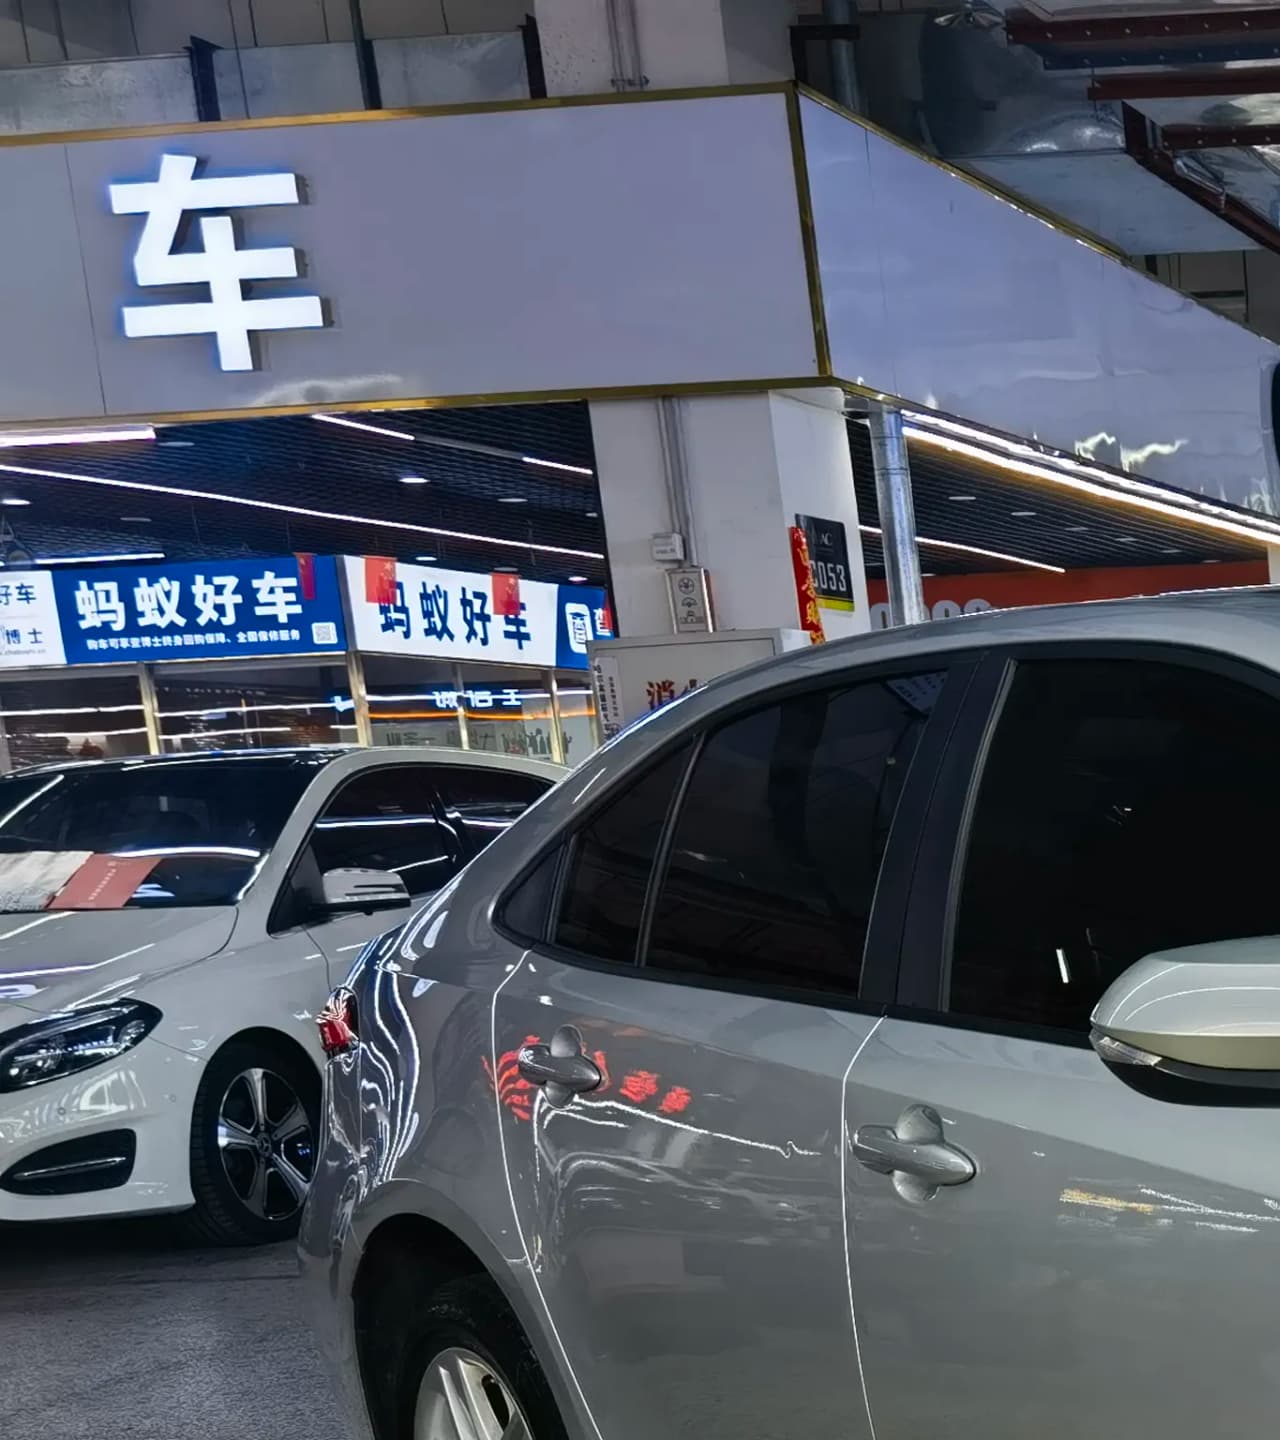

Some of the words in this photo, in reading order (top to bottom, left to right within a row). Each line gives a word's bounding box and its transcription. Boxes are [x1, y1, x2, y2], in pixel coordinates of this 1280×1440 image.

[109, 153, 323, 371] 车
[73, 570, 302, 631] 蚂蚁好车
